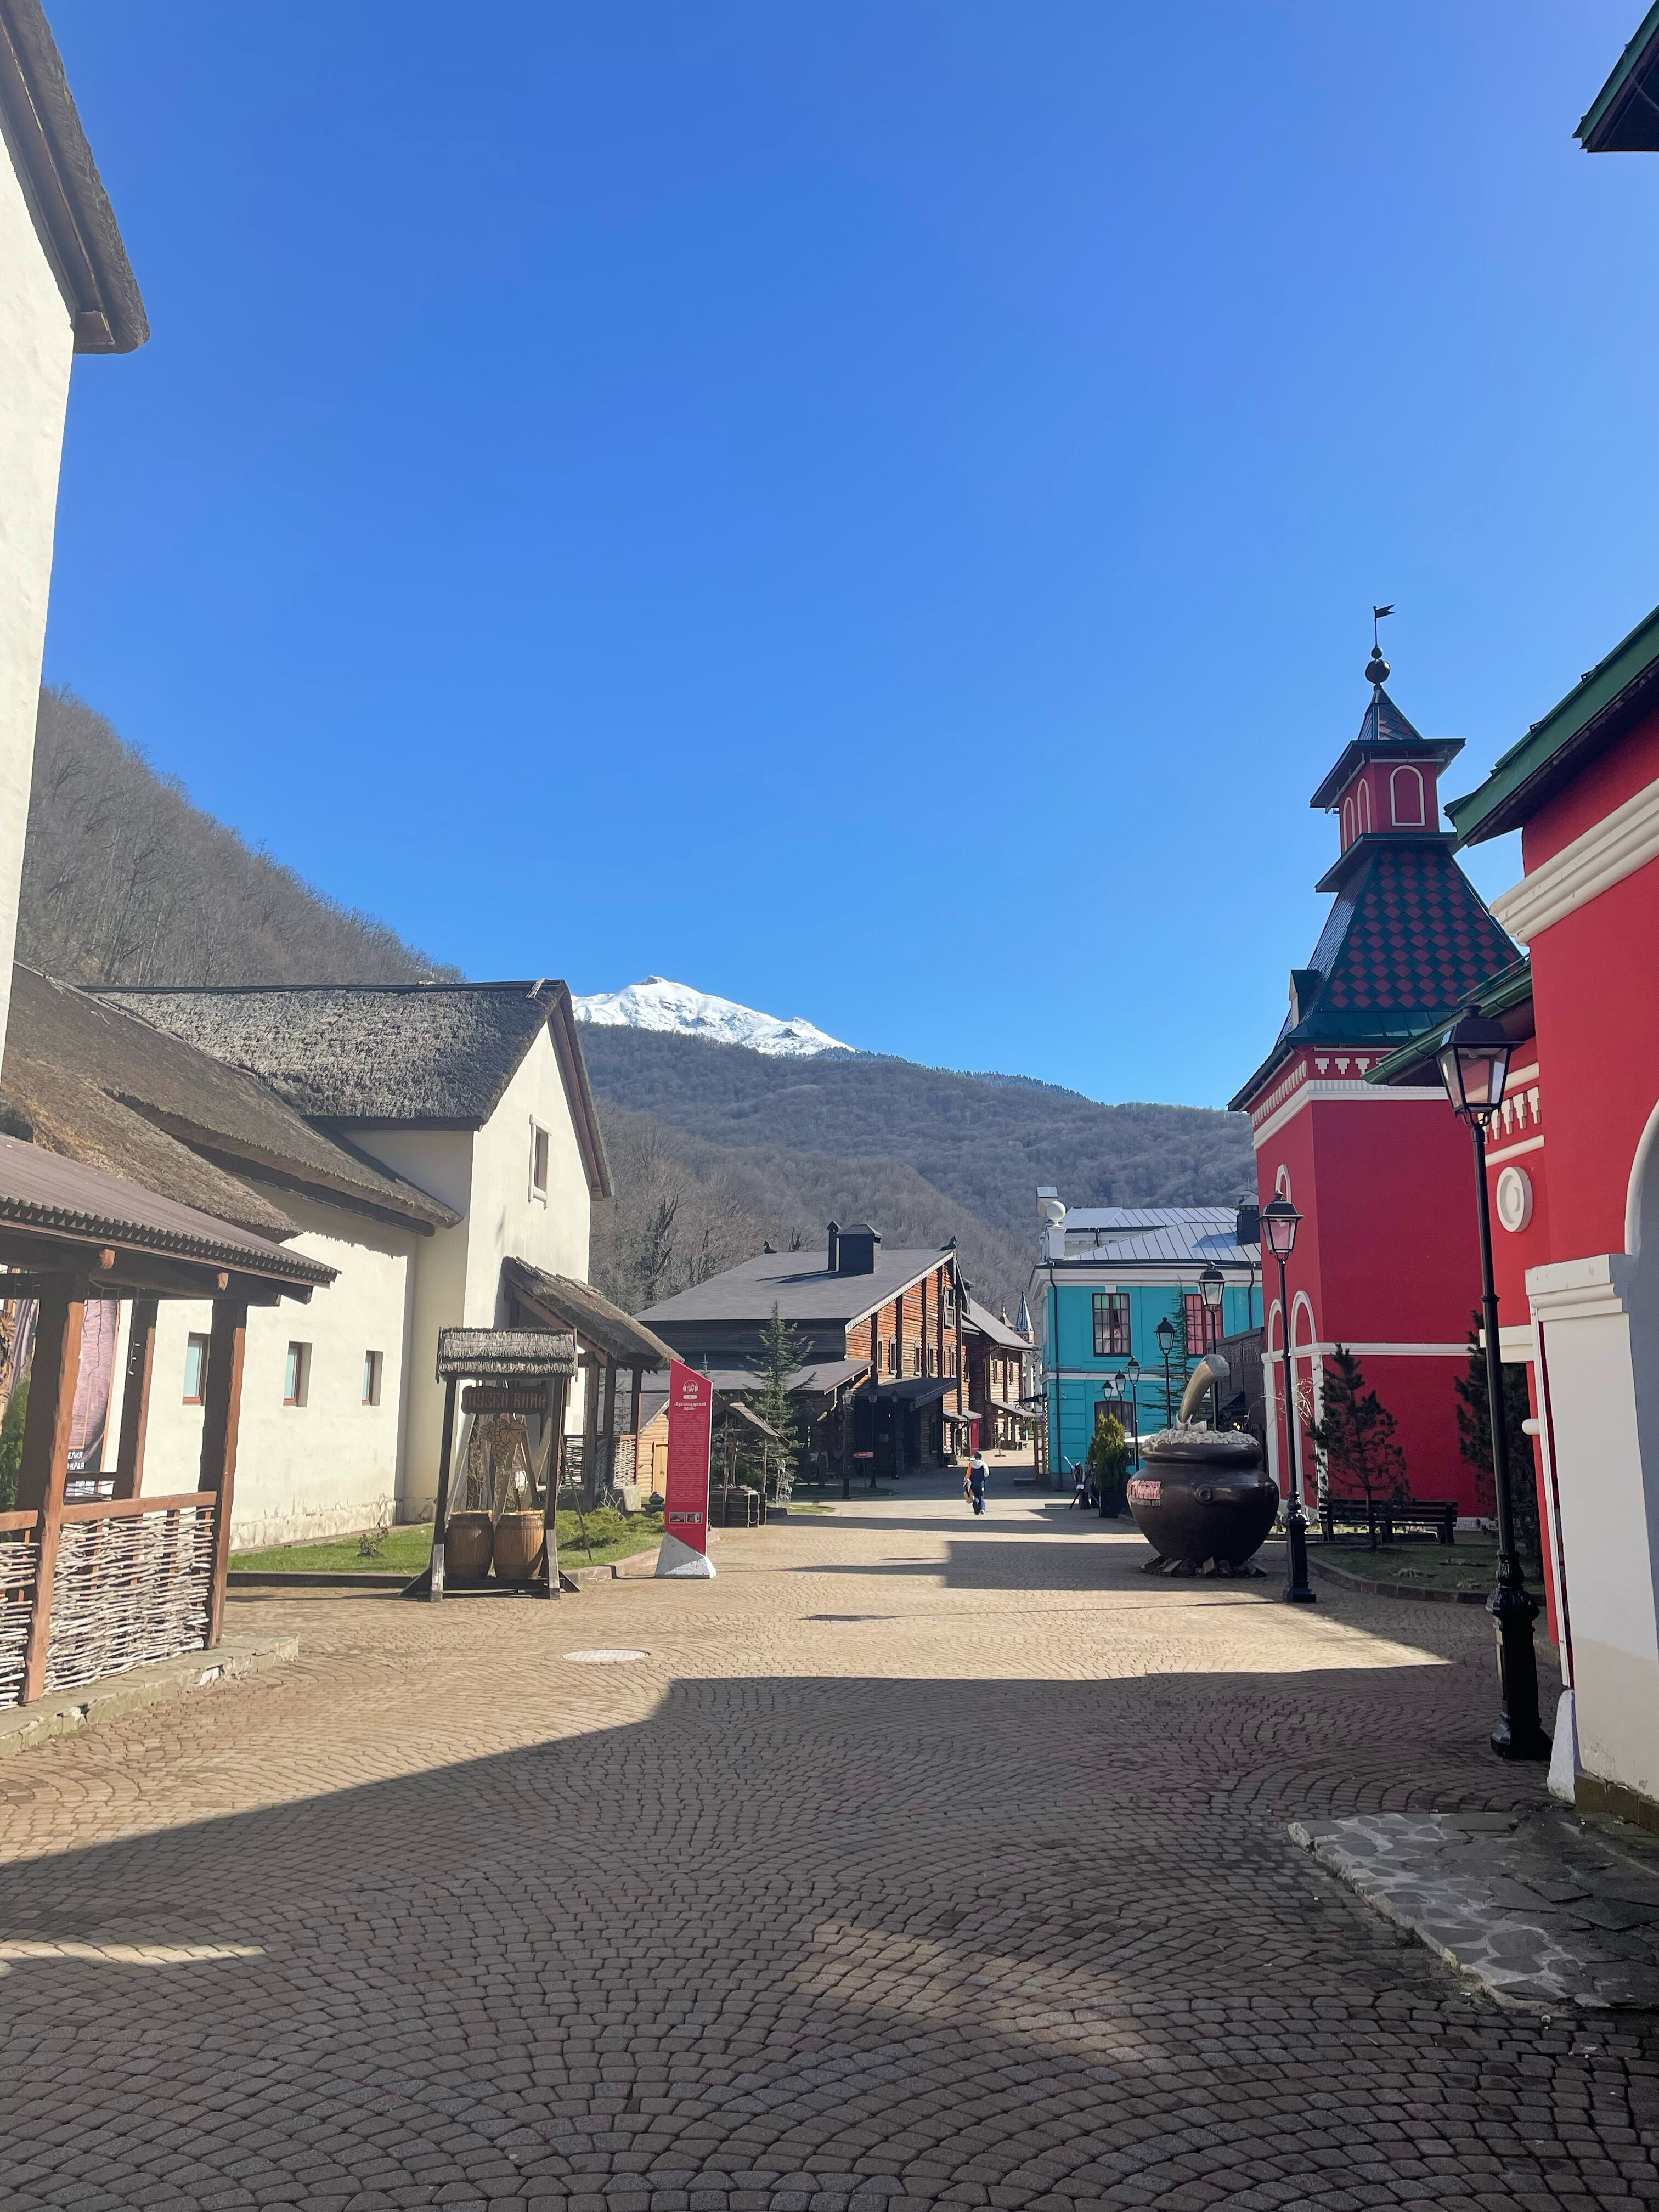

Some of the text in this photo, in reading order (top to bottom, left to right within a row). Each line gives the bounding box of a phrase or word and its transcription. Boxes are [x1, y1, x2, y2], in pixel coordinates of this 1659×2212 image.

[464, 1391, 546, 1408] МУЗЕЙ ВИНА
[70, 1462, 85, 1470] КРАЯ
